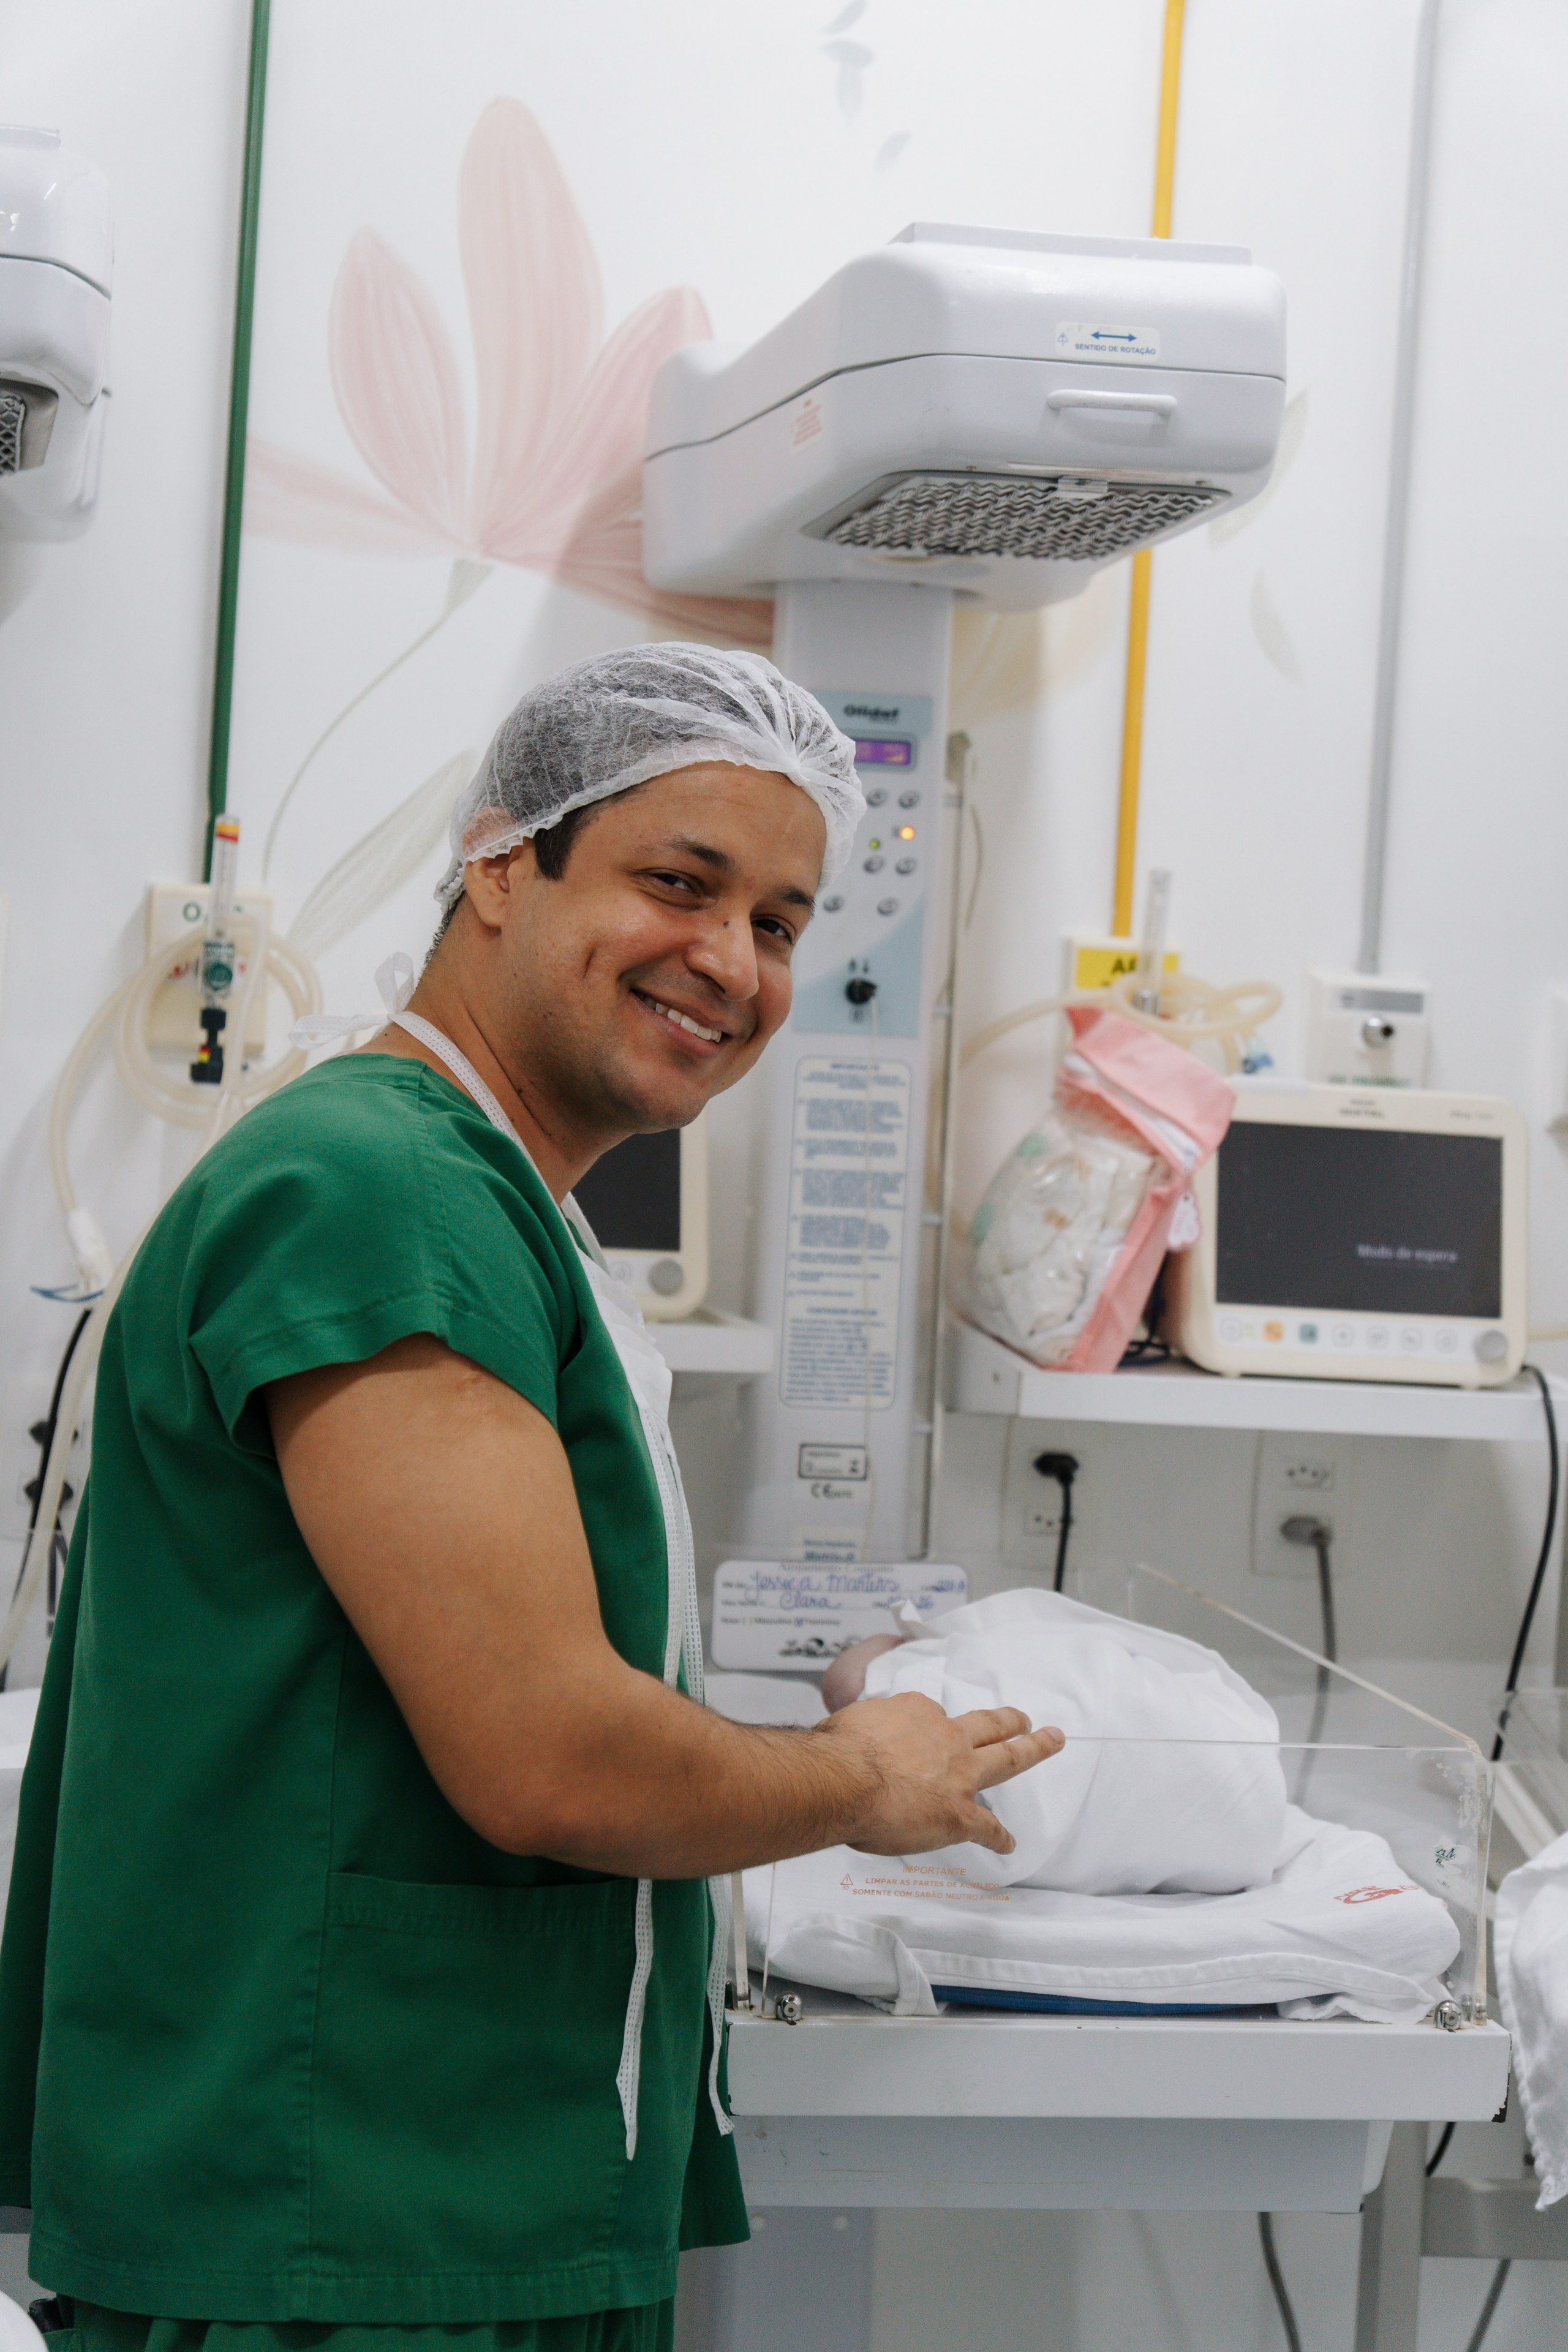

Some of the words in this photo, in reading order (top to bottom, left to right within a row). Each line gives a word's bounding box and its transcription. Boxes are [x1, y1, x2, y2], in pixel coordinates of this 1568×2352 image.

[1120, 346, 1156, 355] ROTAÇÃO
[903, 1866, 967, 1875] IMPORTANTE
[914, 1890, 943, 1899] SABÃO
